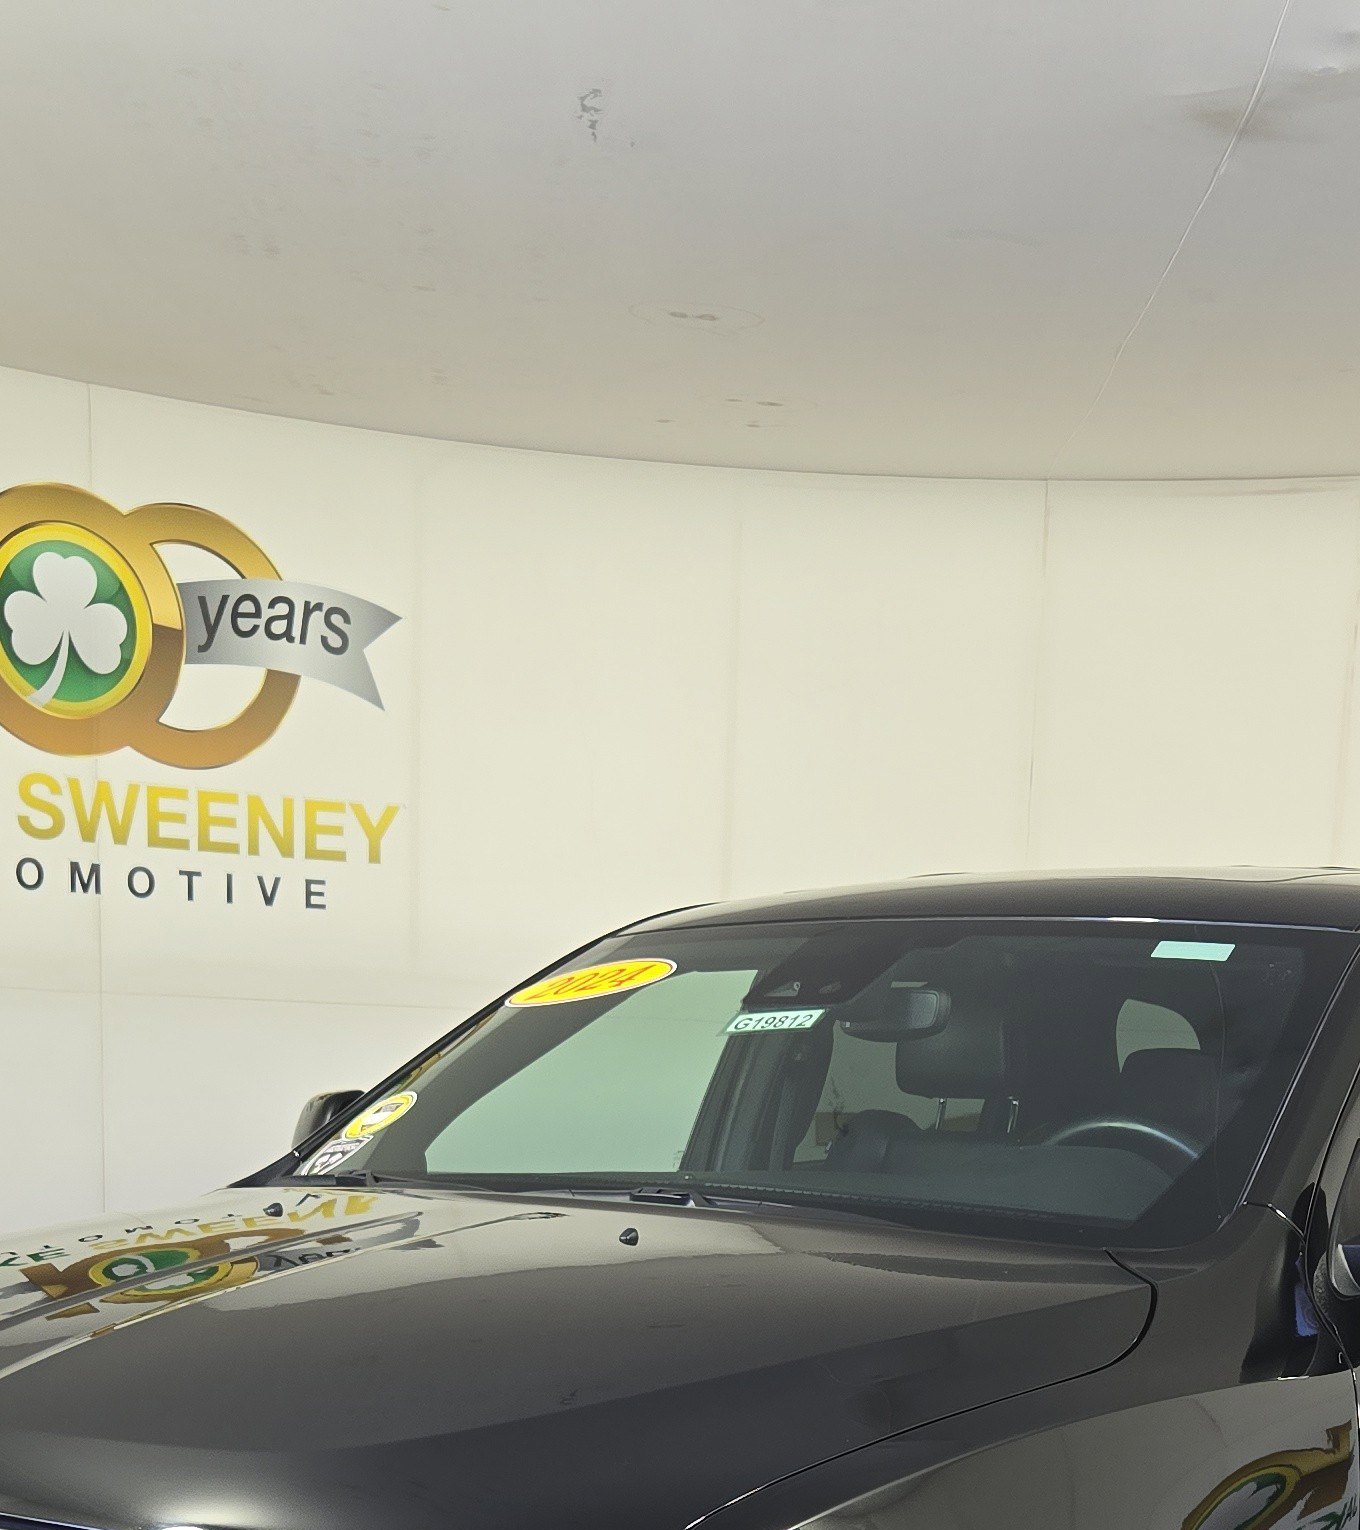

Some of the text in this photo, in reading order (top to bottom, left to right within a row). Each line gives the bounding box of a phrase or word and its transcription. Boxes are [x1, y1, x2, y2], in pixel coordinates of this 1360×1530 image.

[197, 592, 352, 657] years
[17, 773, 400, 864] SWEENEY
[525, 964, 657, 1001] 2024
[734, 1013, 814, 1031] G19812
